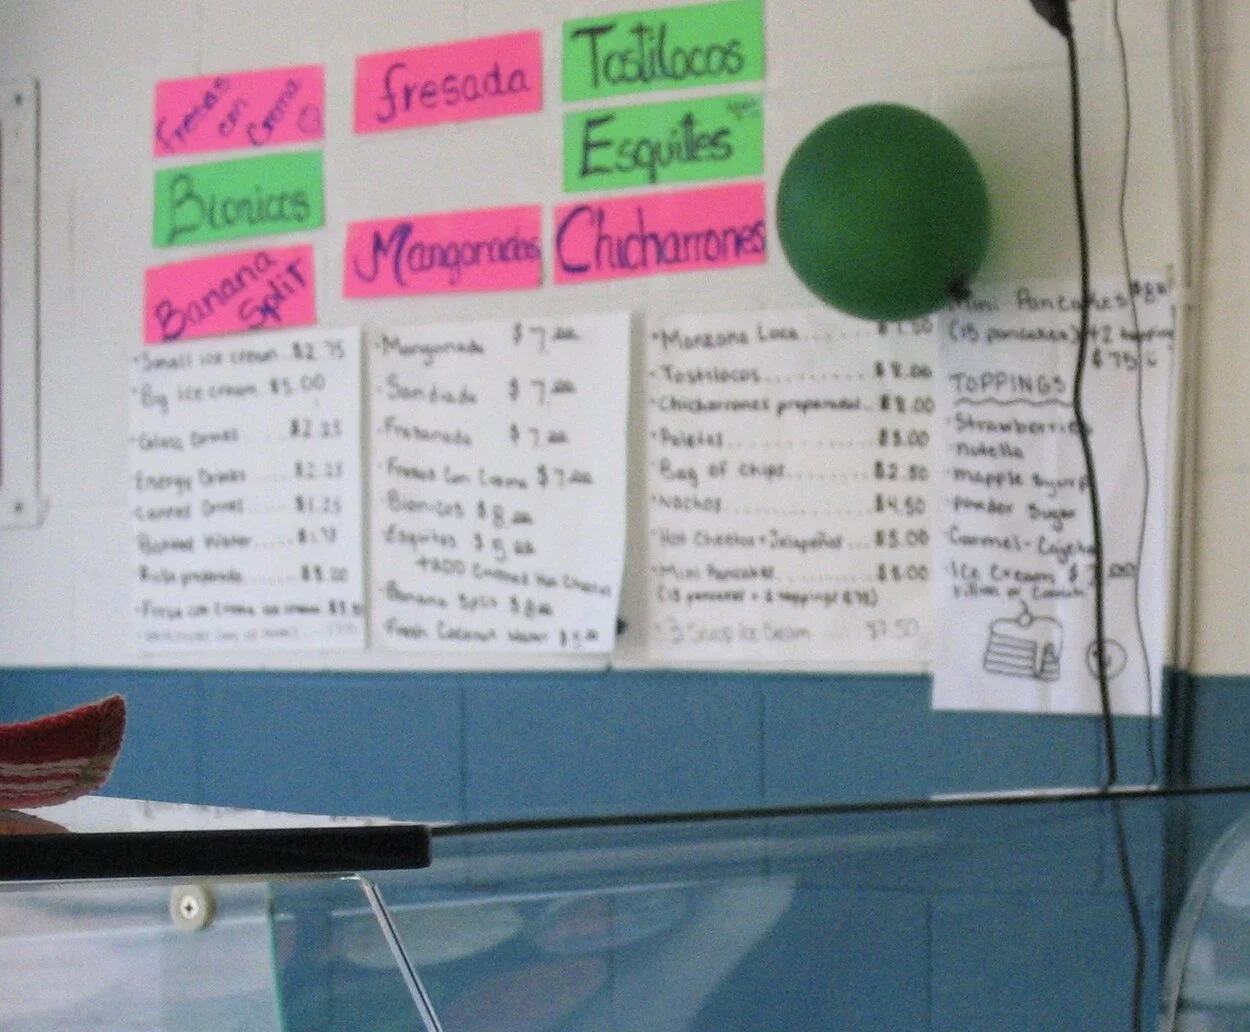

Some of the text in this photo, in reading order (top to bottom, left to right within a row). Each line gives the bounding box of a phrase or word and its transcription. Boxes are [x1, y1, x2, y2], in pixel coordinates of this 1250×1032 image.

[571, 22, 745, 88] Tostilocos
[376, 61, 530, 123] fresada
[581, 111, 734, 184] Esquites
[557, 205, 766, 273] Chicharrones
[156, 251, 277, 342] Banana
[949, 372, 1066, 395] TOPPINGS
